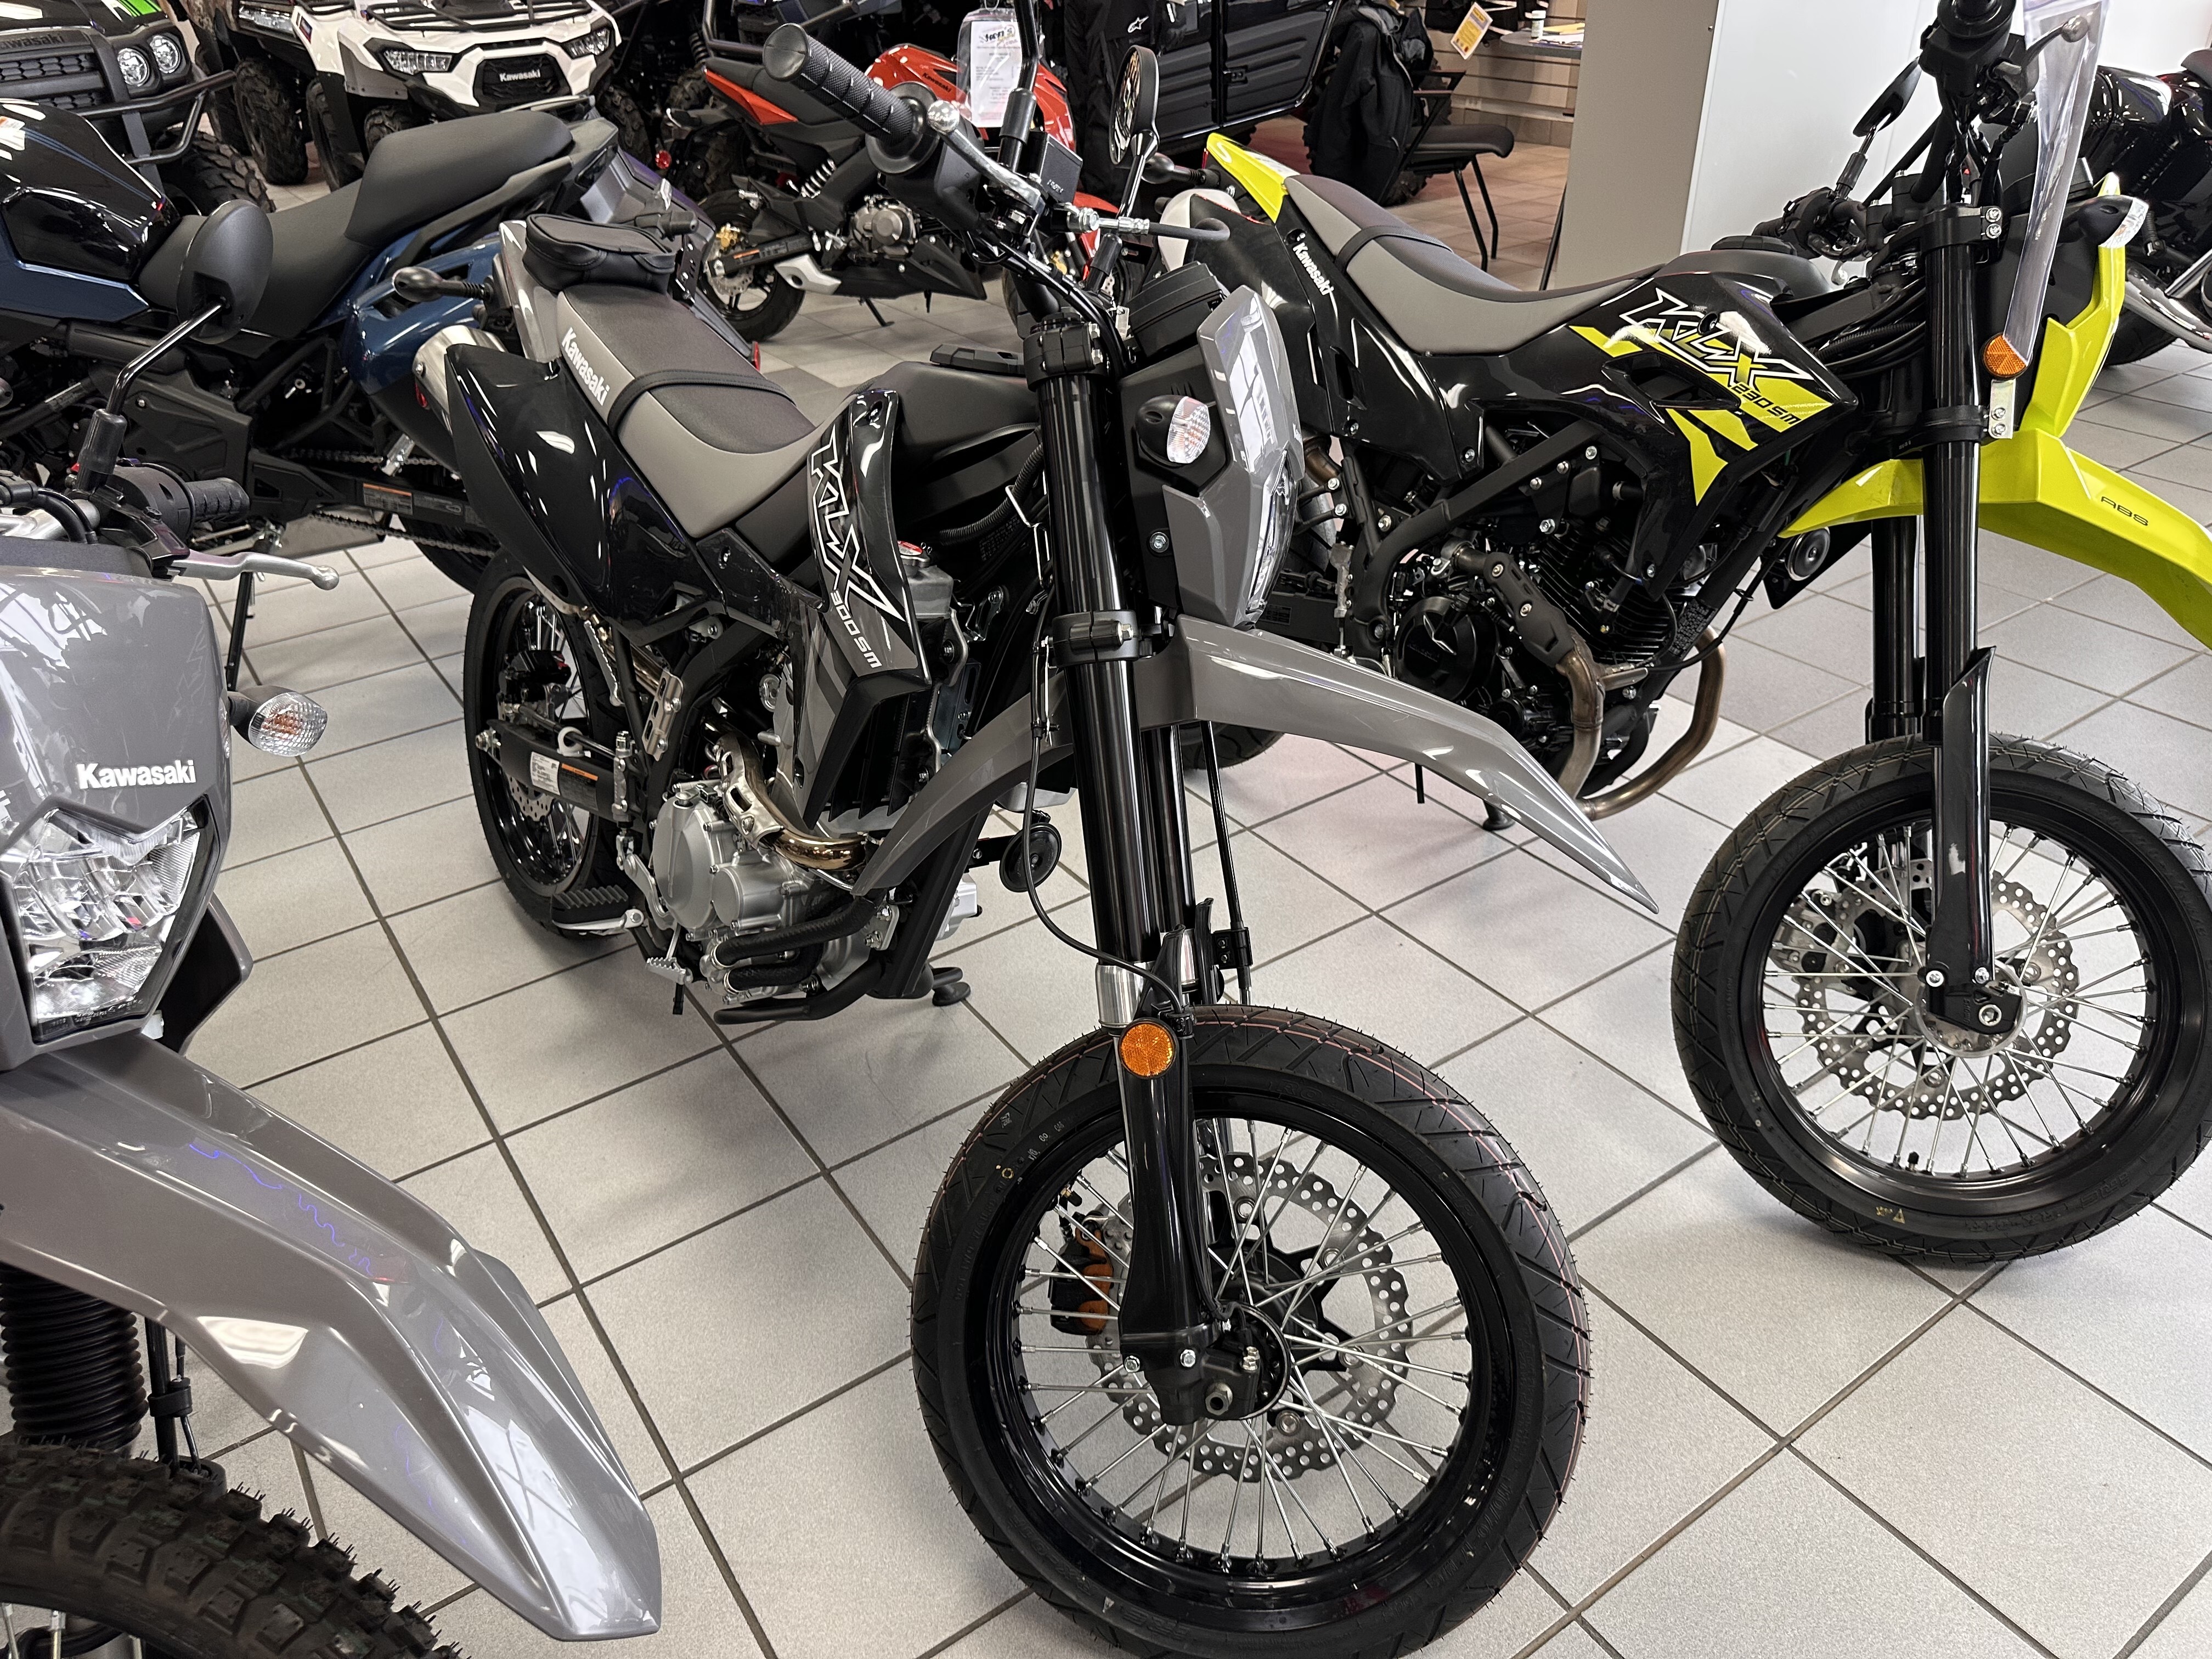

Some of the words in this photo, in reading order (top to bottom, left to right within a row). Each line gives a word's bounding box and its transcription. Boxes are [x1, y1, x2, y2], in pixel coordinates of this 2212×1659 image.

[0, 33, 65, 48] awasaki
[499, 69, 541, 82] Kawasaki
[1293, 242, 1334, 296] Kawasaki
[1619, 287, 1815, 390] KLX
[561, 327, 610, 406] Kawasaki
[811, 424, 906, 622] KLX
[2101, 496, 2148, 526] ABS
[76, 759, 196, 789] Kawasaki
